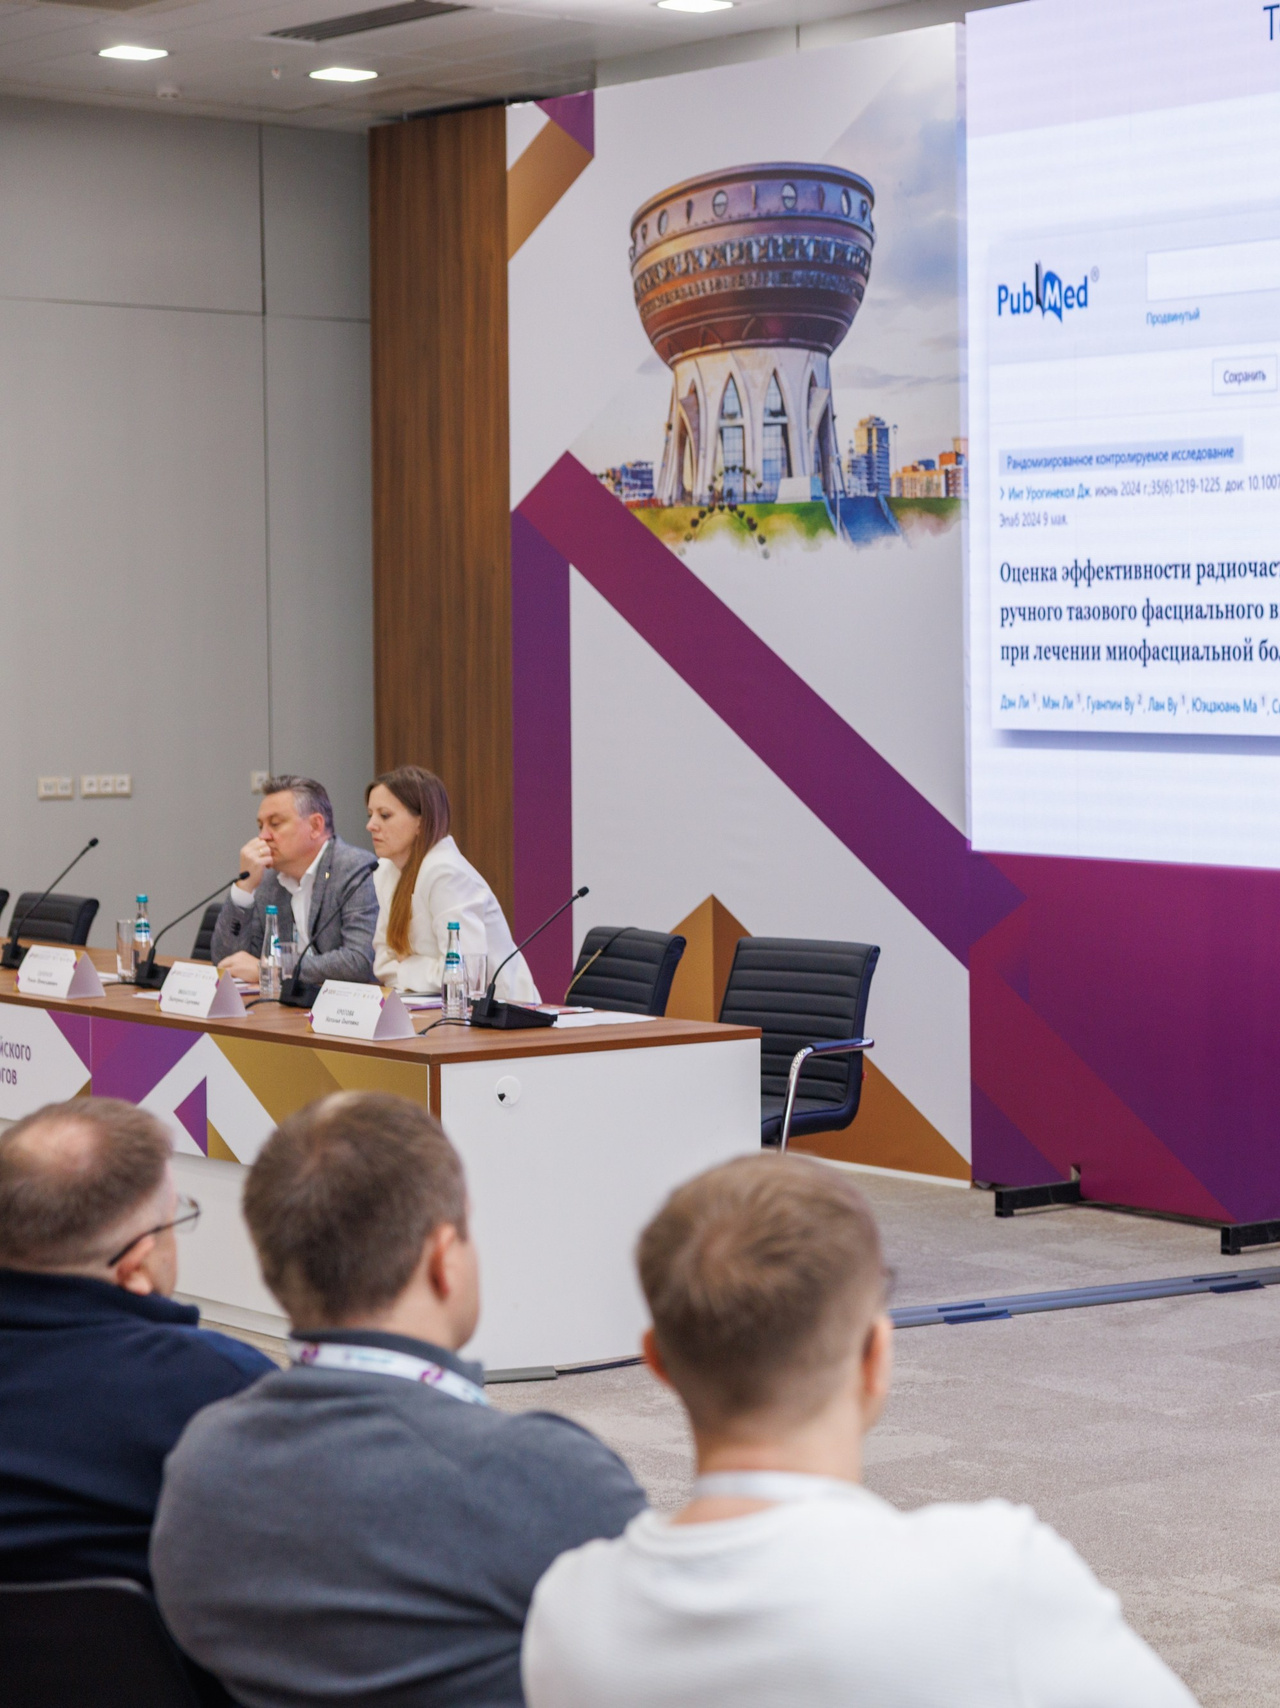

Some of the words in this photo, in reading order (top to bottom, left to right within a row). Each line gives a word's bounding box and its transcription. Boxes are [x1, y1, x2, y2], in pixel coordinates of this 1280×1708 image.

[1223, 369, 1266, 387] Сохранить
[1007, 455, 1093, 471] Рандомизированное
[1096, 450, 1169, 467] контролируемое
[1171, 446, 1234, 462] исследование
[1121, 480, 1141, 496] 2024
[1022, 512, 1041, 527] 2024
[1000, 561, 1057, 583] Оценка
[1061, 558, 1191, 587] эффективности
[1000, 604, 1062, 628] ручного
[1066, 602, 1137, 622] тазового
[1142, 598, 1263, 627] фасциального
[1000, 643, 1029, 666] при
[1033, 643, 1101, 661] лечении
[1106, 638, 1253, 667] миофасциальной
[0, 1067, 17, 1085] ГОВ
